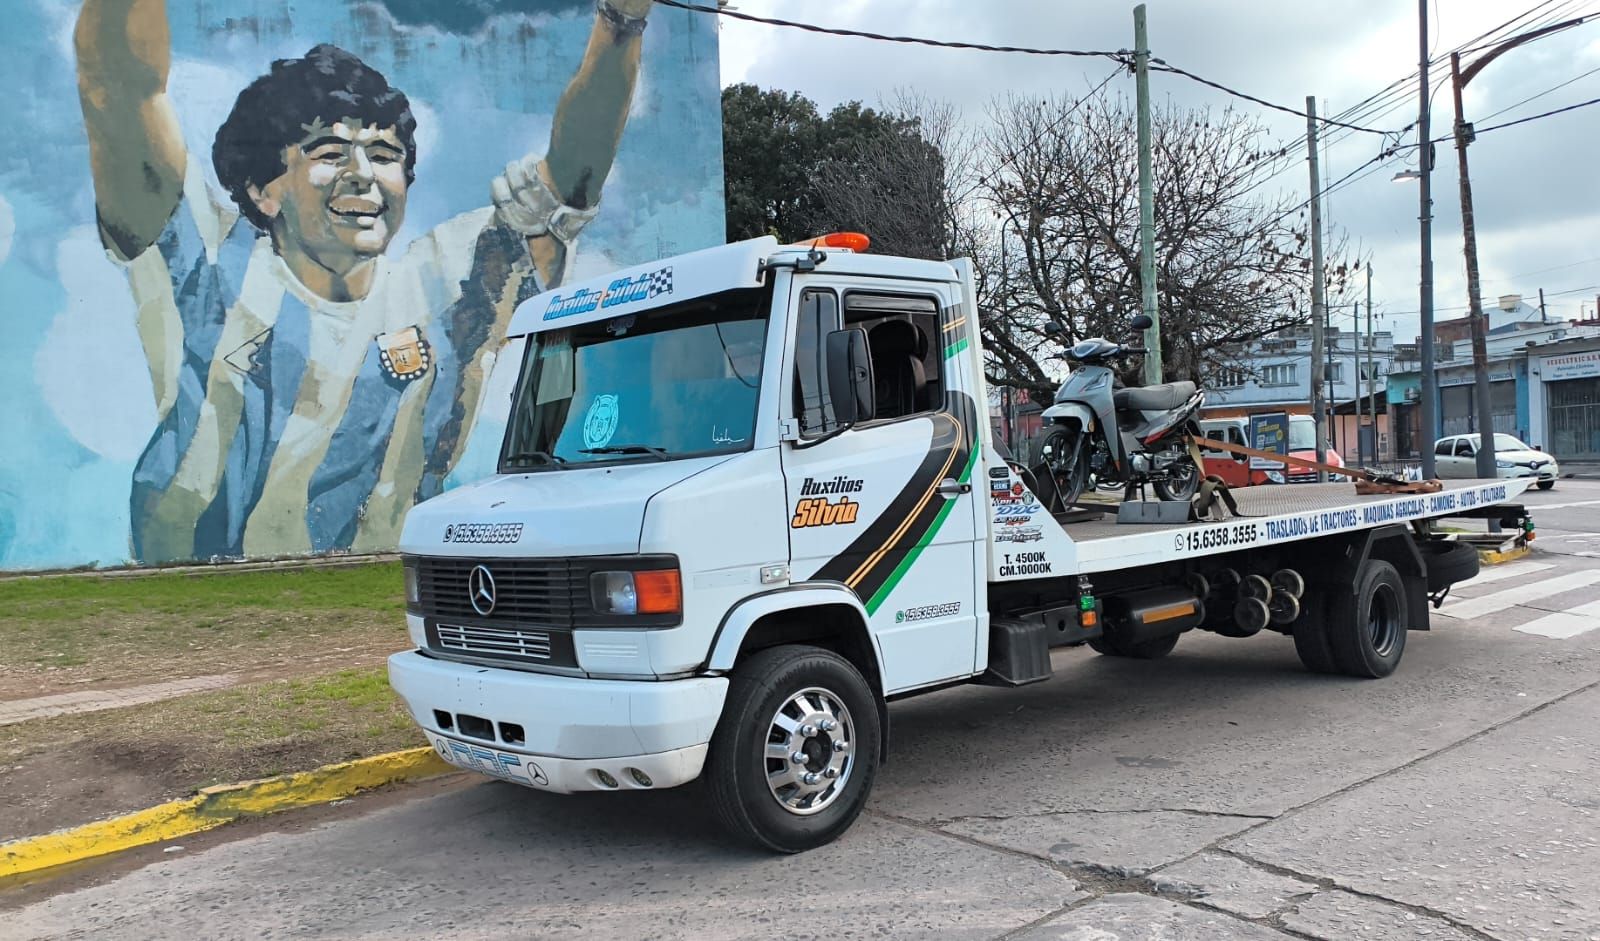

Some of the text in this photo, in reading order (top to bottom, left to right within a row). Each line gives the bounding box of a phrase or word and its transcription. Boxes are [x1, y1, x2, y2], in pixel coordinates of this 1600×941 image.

[800, 476, 864, 496] Auxilios
[791, 495, 859, 529] Silvia
[453, 523, 524, 544] 15.6358.3555
[1186, 524, 1257, 551] 15.6358.3555
[1266, 518, 1308, 541] TRASLADOS
[1320, 509, 1357, 531] TRACTORES
[1363, 503, 1394, 524] MAQUINAS
[1004, 552, 1046, 564] T. 4500K
[905, 601, 961, 622] 15.6358.3555
